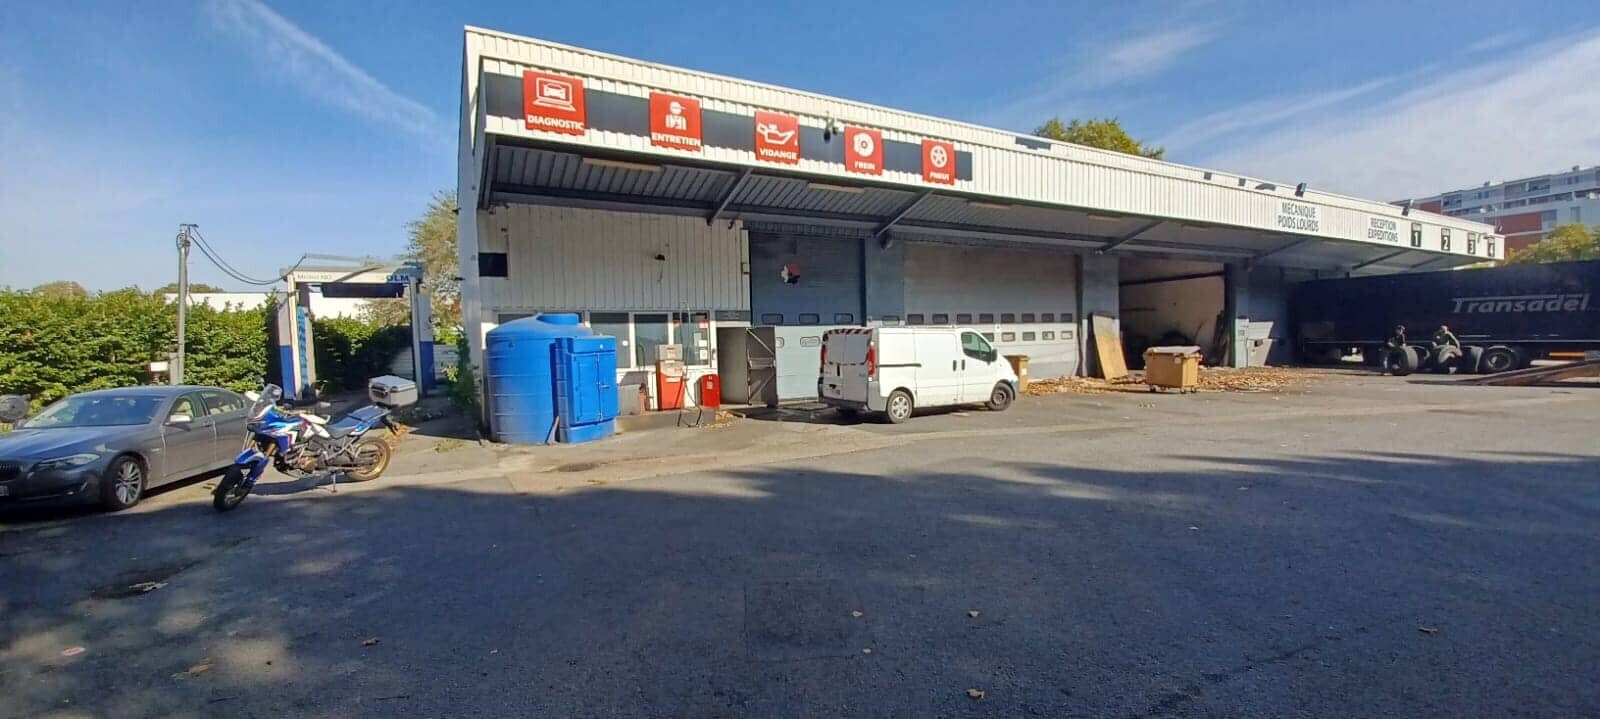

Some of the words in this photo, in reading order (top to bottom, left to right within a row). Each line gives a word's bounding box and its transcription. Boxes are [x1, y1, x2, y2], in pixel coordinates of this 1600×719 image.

[528, 114, 585, 130] DIAGNOSTIC
[651, 132, 701, 146] ENTRETIEN
[759, 147, 797, 160] VIDANGE
[1278, 214, 1296, 228] POIDS
[1296, 217, 1319, 232] LOURDS
[1443, 236, 1449, 250] 2
[1451, 293, 1591, 314] Transadel
